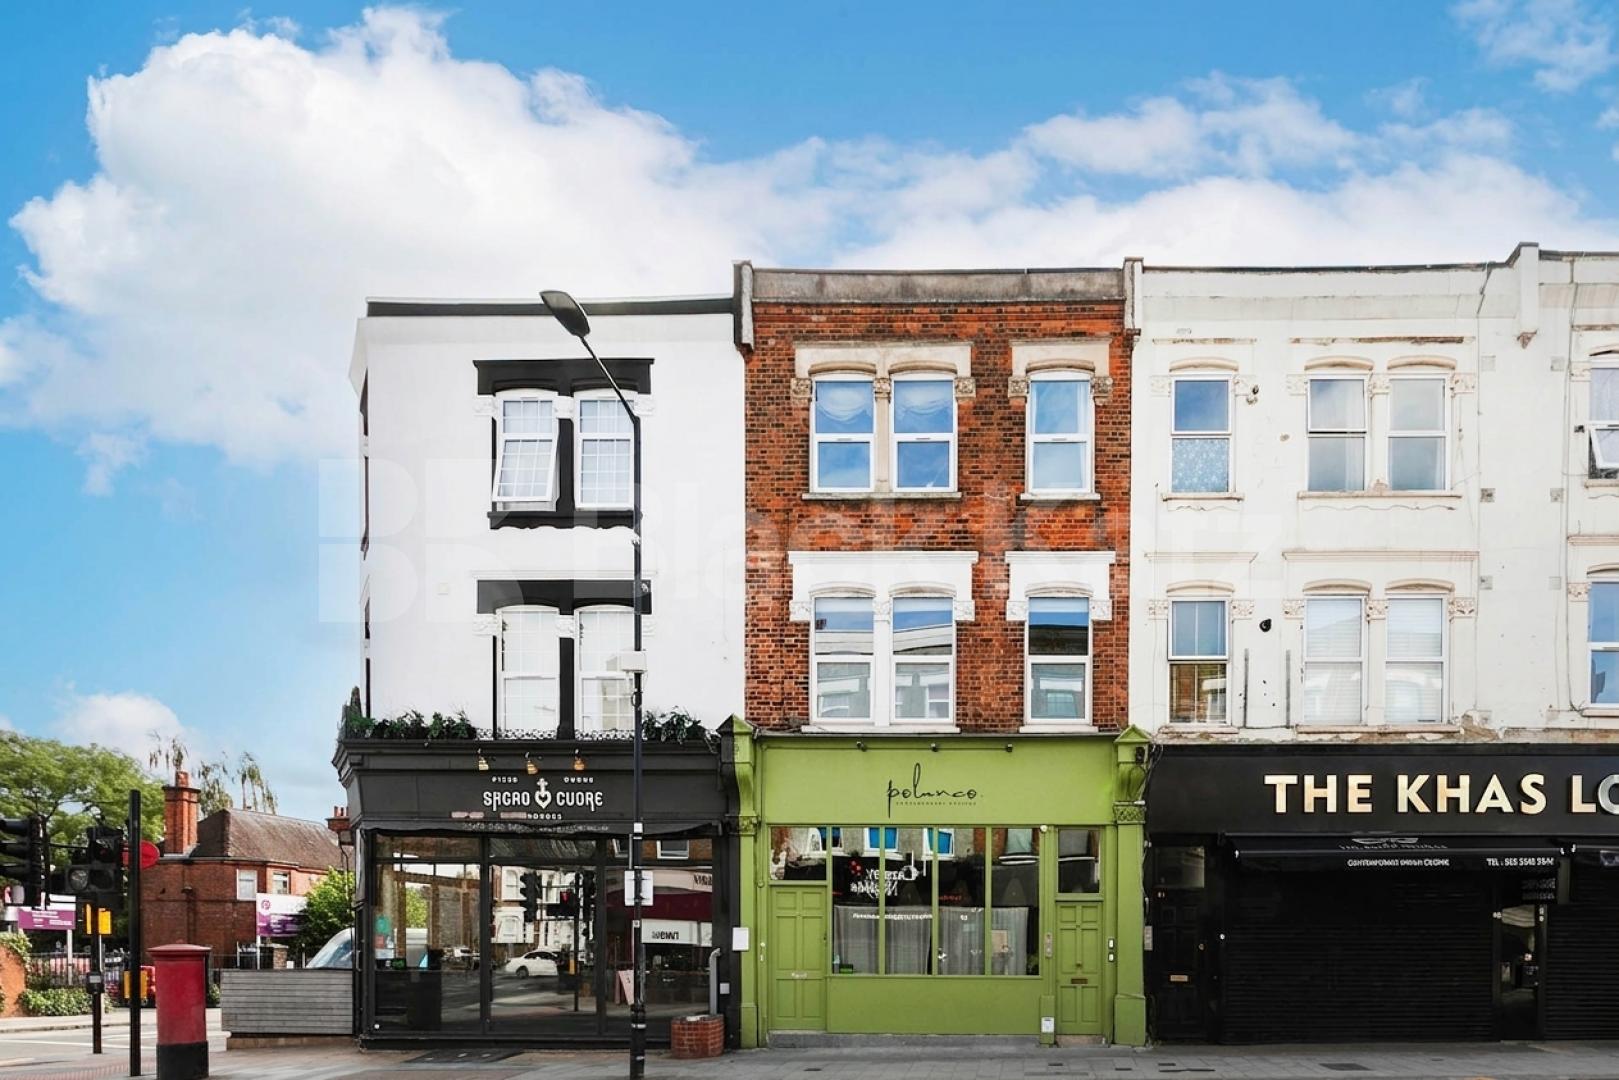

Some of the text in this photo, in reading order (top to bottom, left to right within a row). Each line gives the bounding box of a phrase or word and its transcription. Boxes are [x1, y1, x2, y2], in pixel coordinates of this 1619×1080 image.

[556, 791, 603, 812] CUORE
[1264, 774, 1373, 814] THE
[1396, 773, 1547, 815] KHAS
